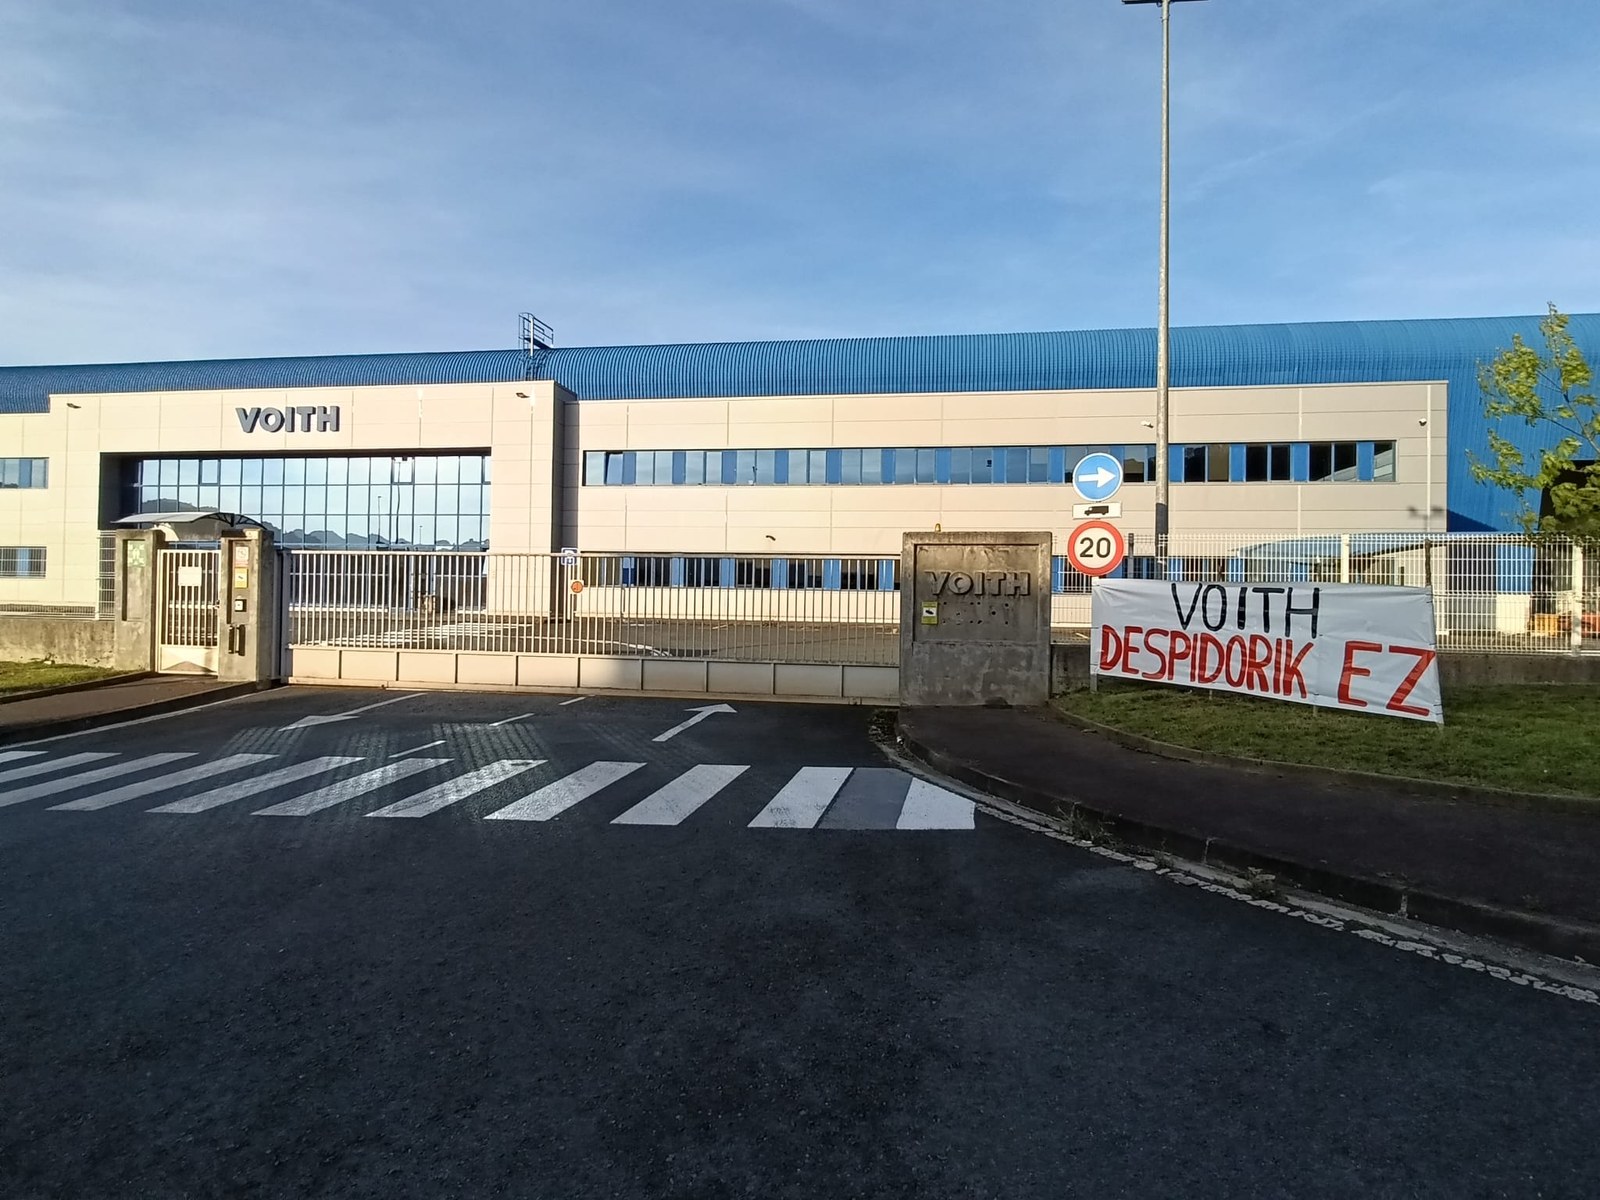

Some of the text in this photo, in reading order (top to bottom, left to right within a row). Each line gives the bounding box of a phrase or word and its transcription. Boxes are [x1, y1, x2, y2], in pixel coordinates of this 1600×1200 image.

[235, 406, 340, 433] VOITH
[1080, 537, 1111, 558] 20
[923, 570, 1031, 597] VOITH
[1171, 582, 1320, 639] VOITH
[1099, 624, 1436, 716] DESPIDORIK EZ
